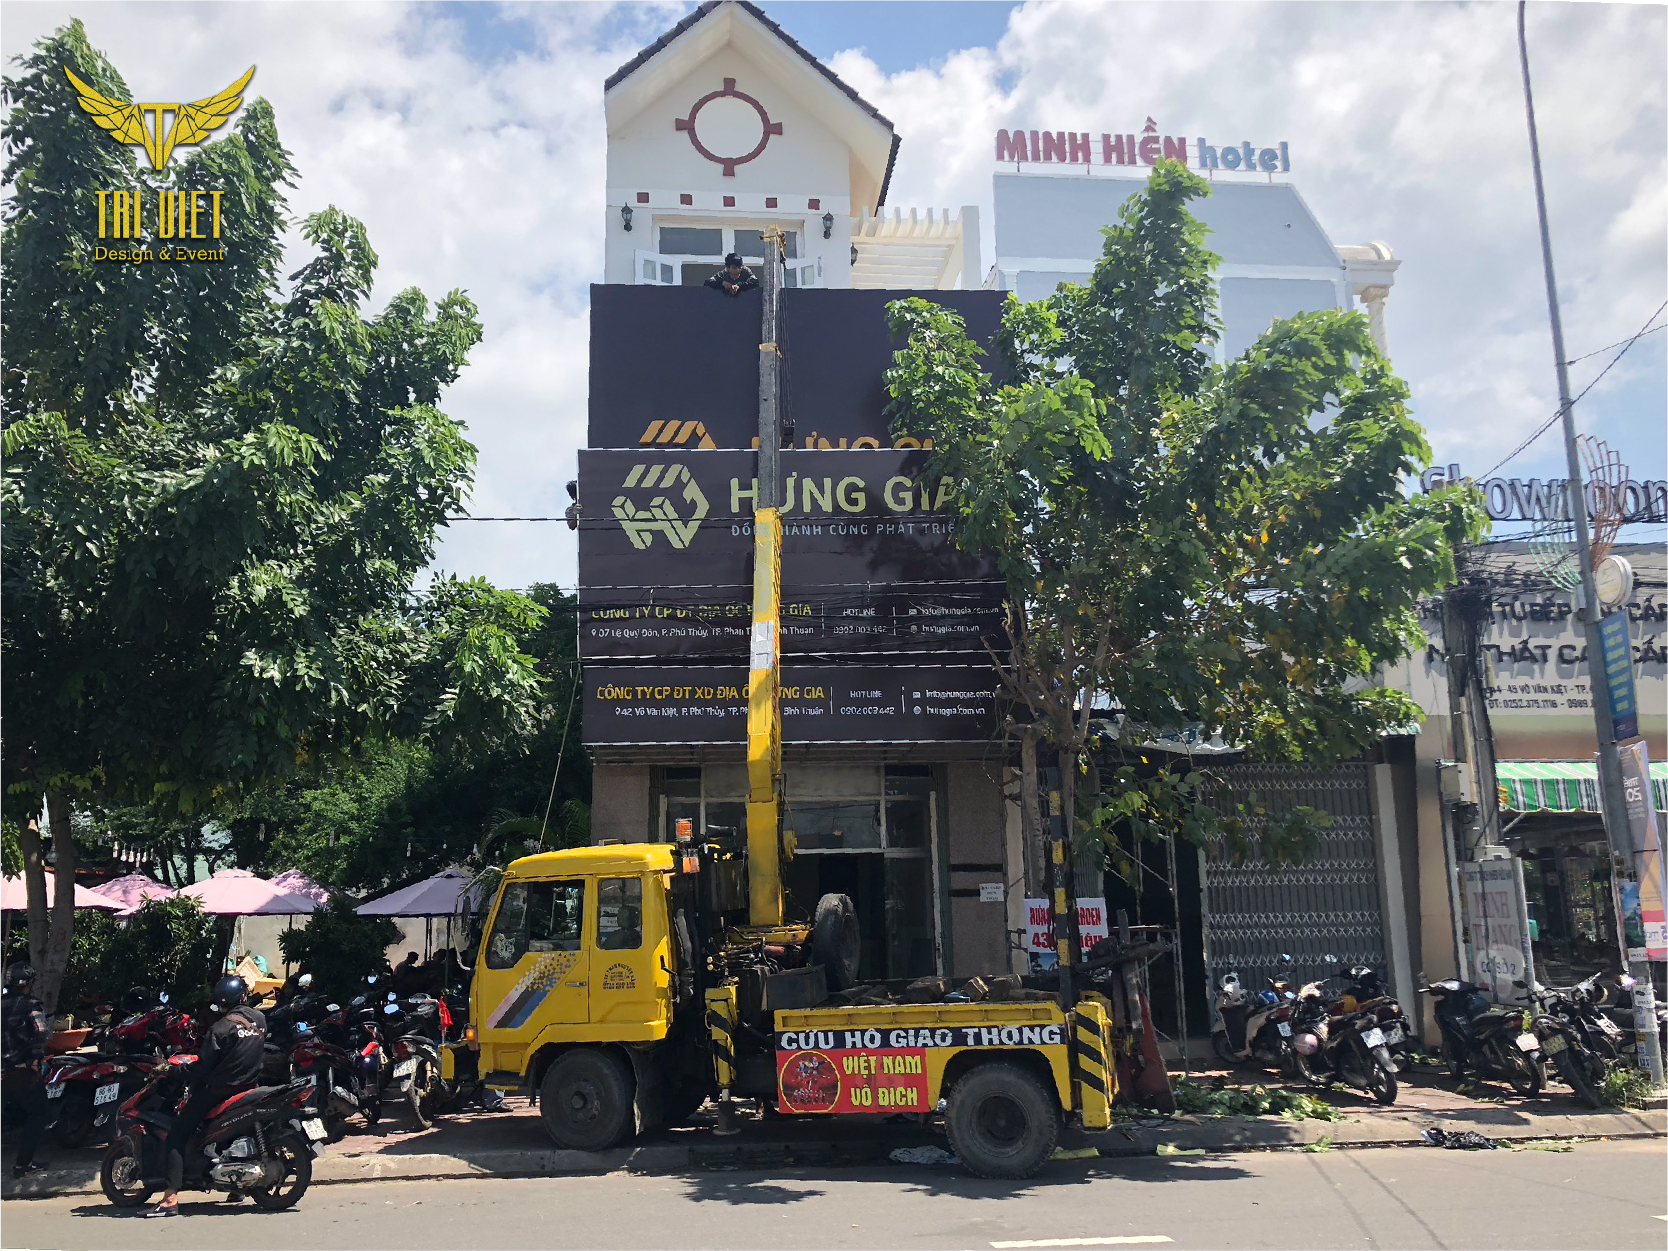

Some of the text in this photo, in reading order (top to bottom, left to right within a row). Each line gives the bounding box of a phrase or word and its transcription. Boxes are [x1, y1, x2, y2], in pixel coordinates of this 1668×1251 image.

[996, 115, 1291, 173] MINH HIỀN hotel
[829, 523, 868, 535] CÙNG
[876, 522, 914, 535] PHÁT
[789, 604, 811, 615] GIA
[843, 608, 875, 616] HOTLINE
[599, 628, 610, 637] 07
[724, 627, 744, 636] Phan
[596, 683, 632, 700] CÔNG
[634, 686, 653, 699] TY
[654, 686, 671, 700] CP
[673, 686, 692, 699] ĐT
[694, 686, 714, 699] XD
[716, 686, 739, 701] ĐỊA
[803, 686, 825, 699] GIA
[850, 690, 883, 698] HOTLINE
[840, 706, 861, 715] 0902
[879, 706, 895, 715] 442
[781, 1029, 835, 1050] CỨU
[889, 1028, 953, 1048] GIAO
[842, 1052, 922, 1078] VIỆT NAM
[850, 1084, 918, 1109] VÔ ĐỊCH
